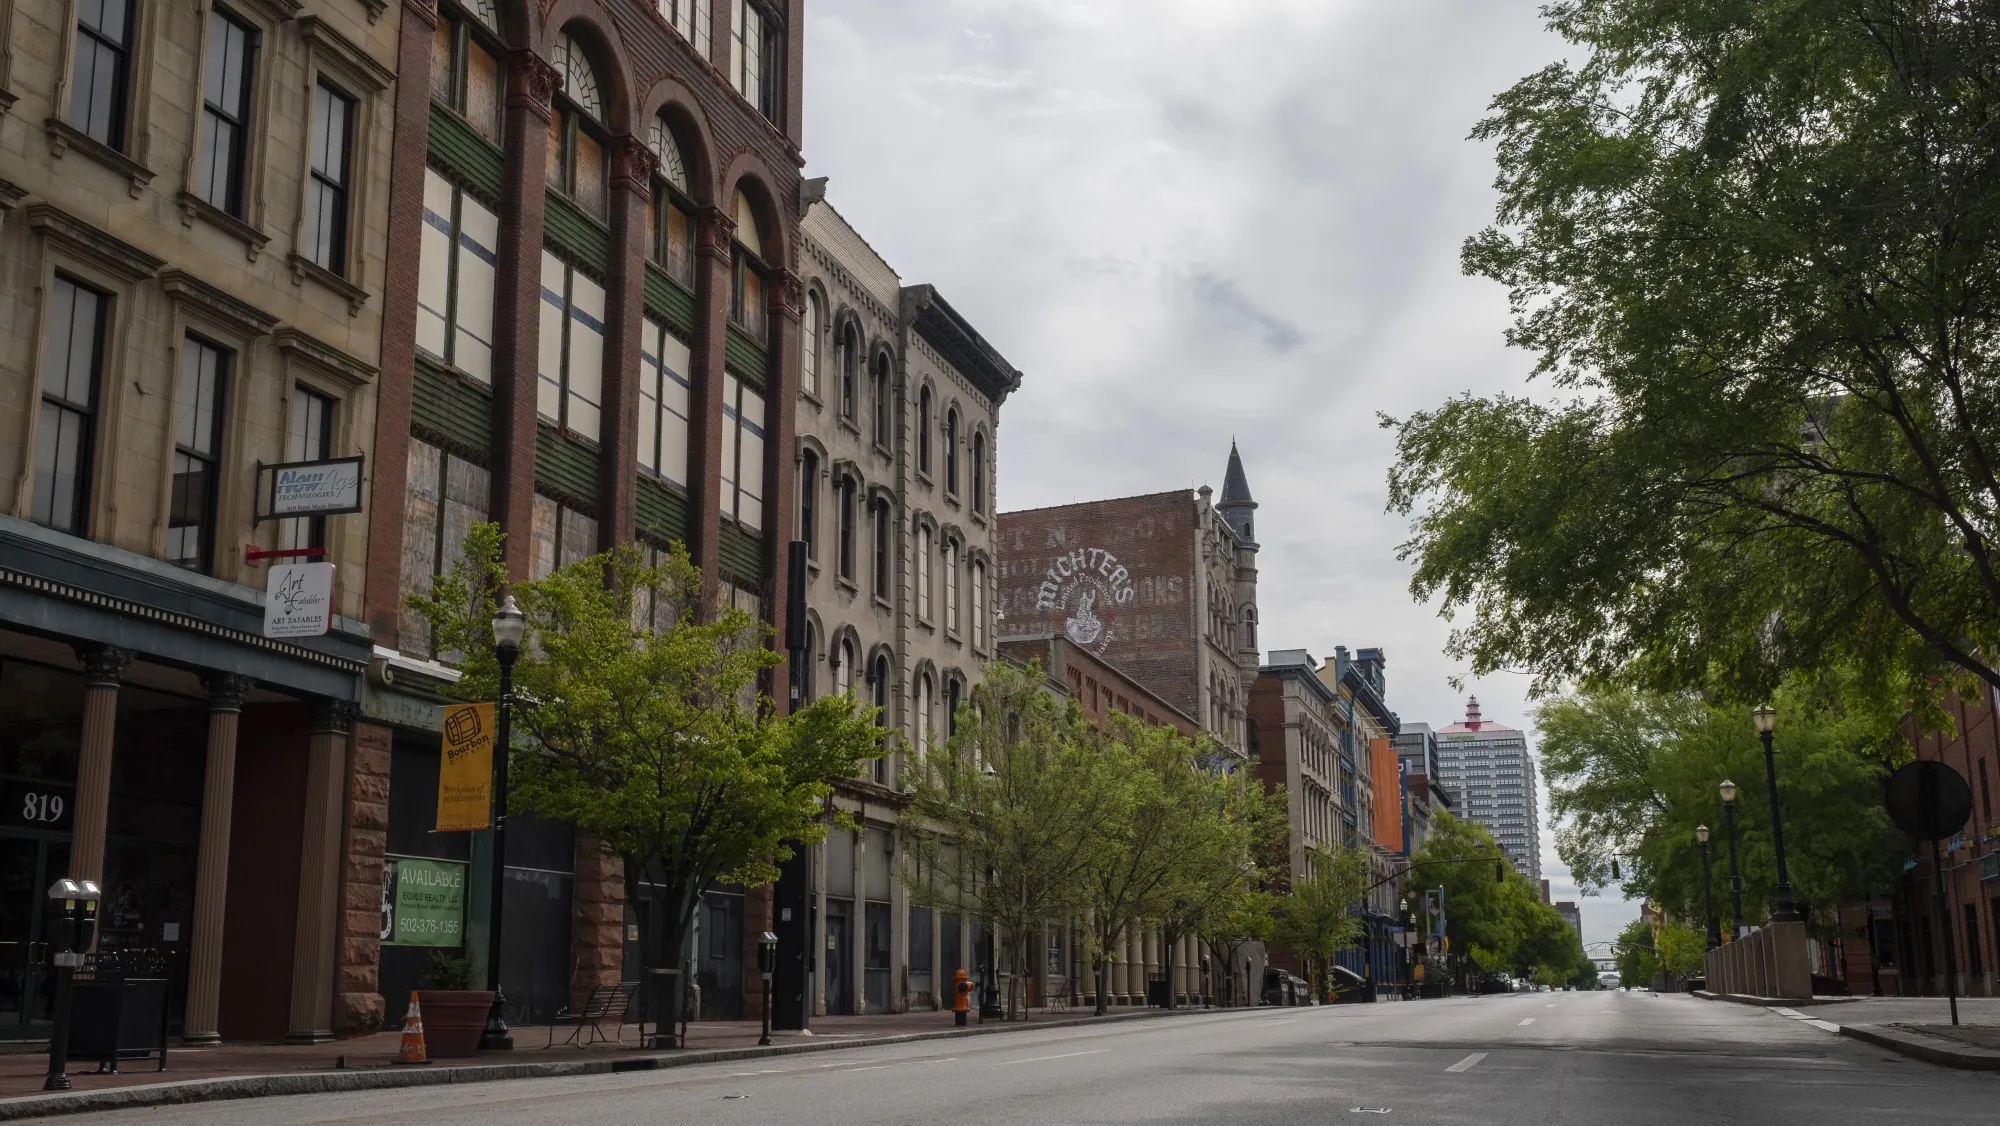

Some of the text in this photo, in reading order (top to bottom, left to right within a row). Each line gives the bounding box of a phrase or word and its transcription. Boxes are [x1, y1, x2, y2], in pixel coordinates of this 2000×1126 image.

[278, 491, 334, 500] TECHNOLOGIES
[275, 569, 305, 600] Art
[1036, 547, 1134, 611] MICHTER'S
[1056, 578, 1079, 610] Limited
[1079, 573, 1112, 605] Production
[447, 734, 489, 759] Bourbon
[450, 741, 490, 764] DISTRICT
[443, 782, 485, 795] Birthplace of
[443, 794, 486, 802] BOURBONISM
[23, 792, 64, 822] 819
[400, 867, 461, 888] AVAILABLE
[400, 918, 459, 934] 502-376-1355
